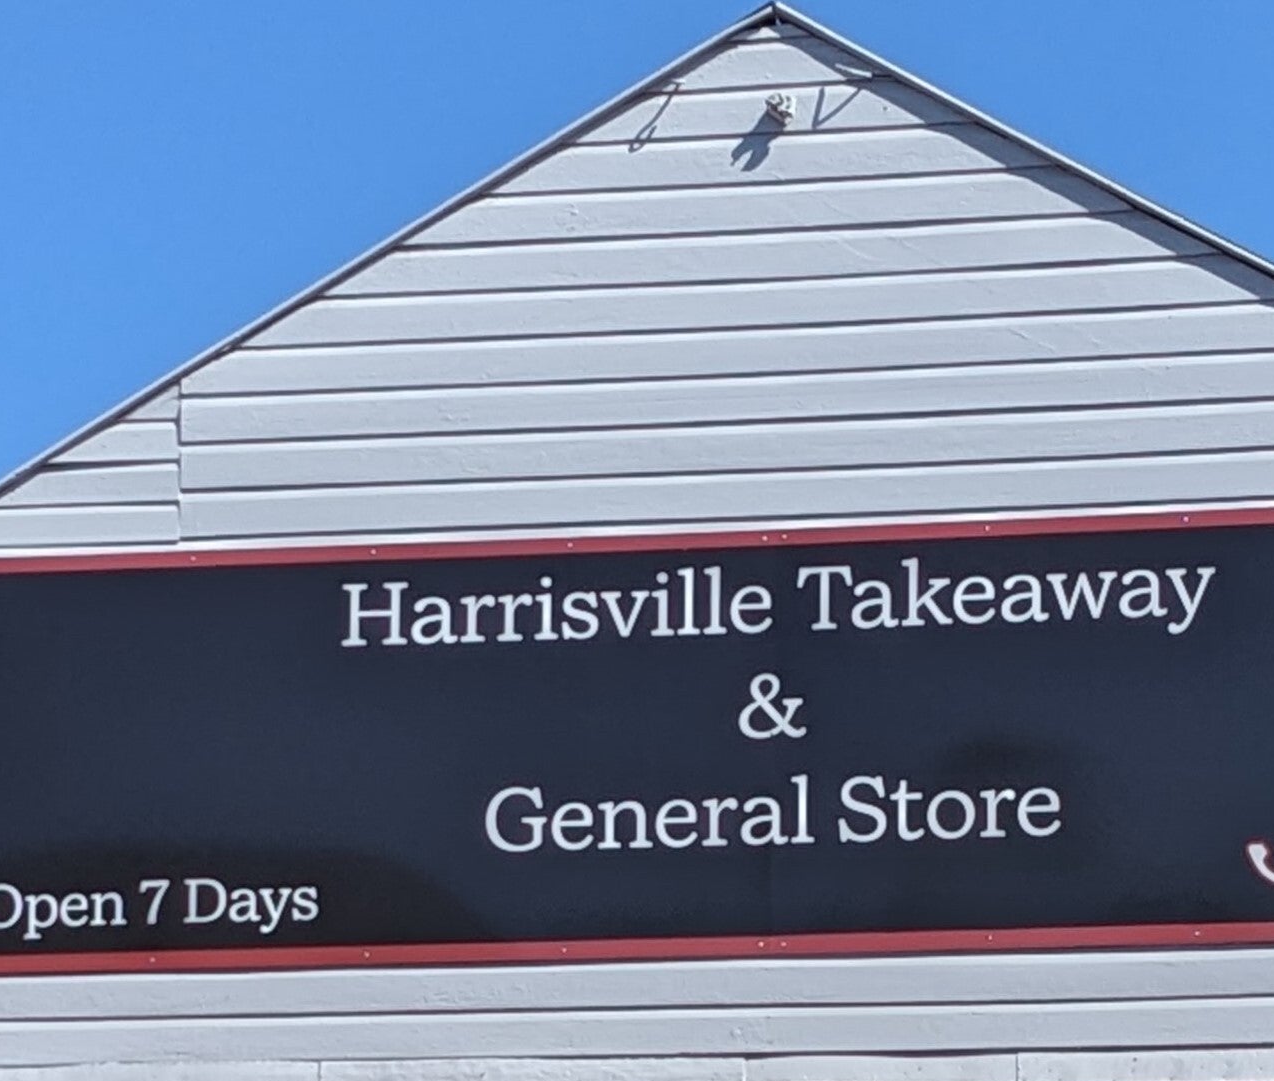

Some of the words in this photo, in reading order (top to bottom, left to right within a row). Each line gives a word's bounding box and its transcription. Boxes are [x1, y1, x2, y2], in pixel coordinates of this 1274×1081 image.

[342, 567, 772, 646] Harrisville
[797, 558, 1215, 634] Takeaway
[739, 674, 806, 739] &
[486, 775, 814, 852] General
[838, 776, 1060, 842] Store
[140, 880, 169, 924] 7
[184, 879, 318, 933] Days
